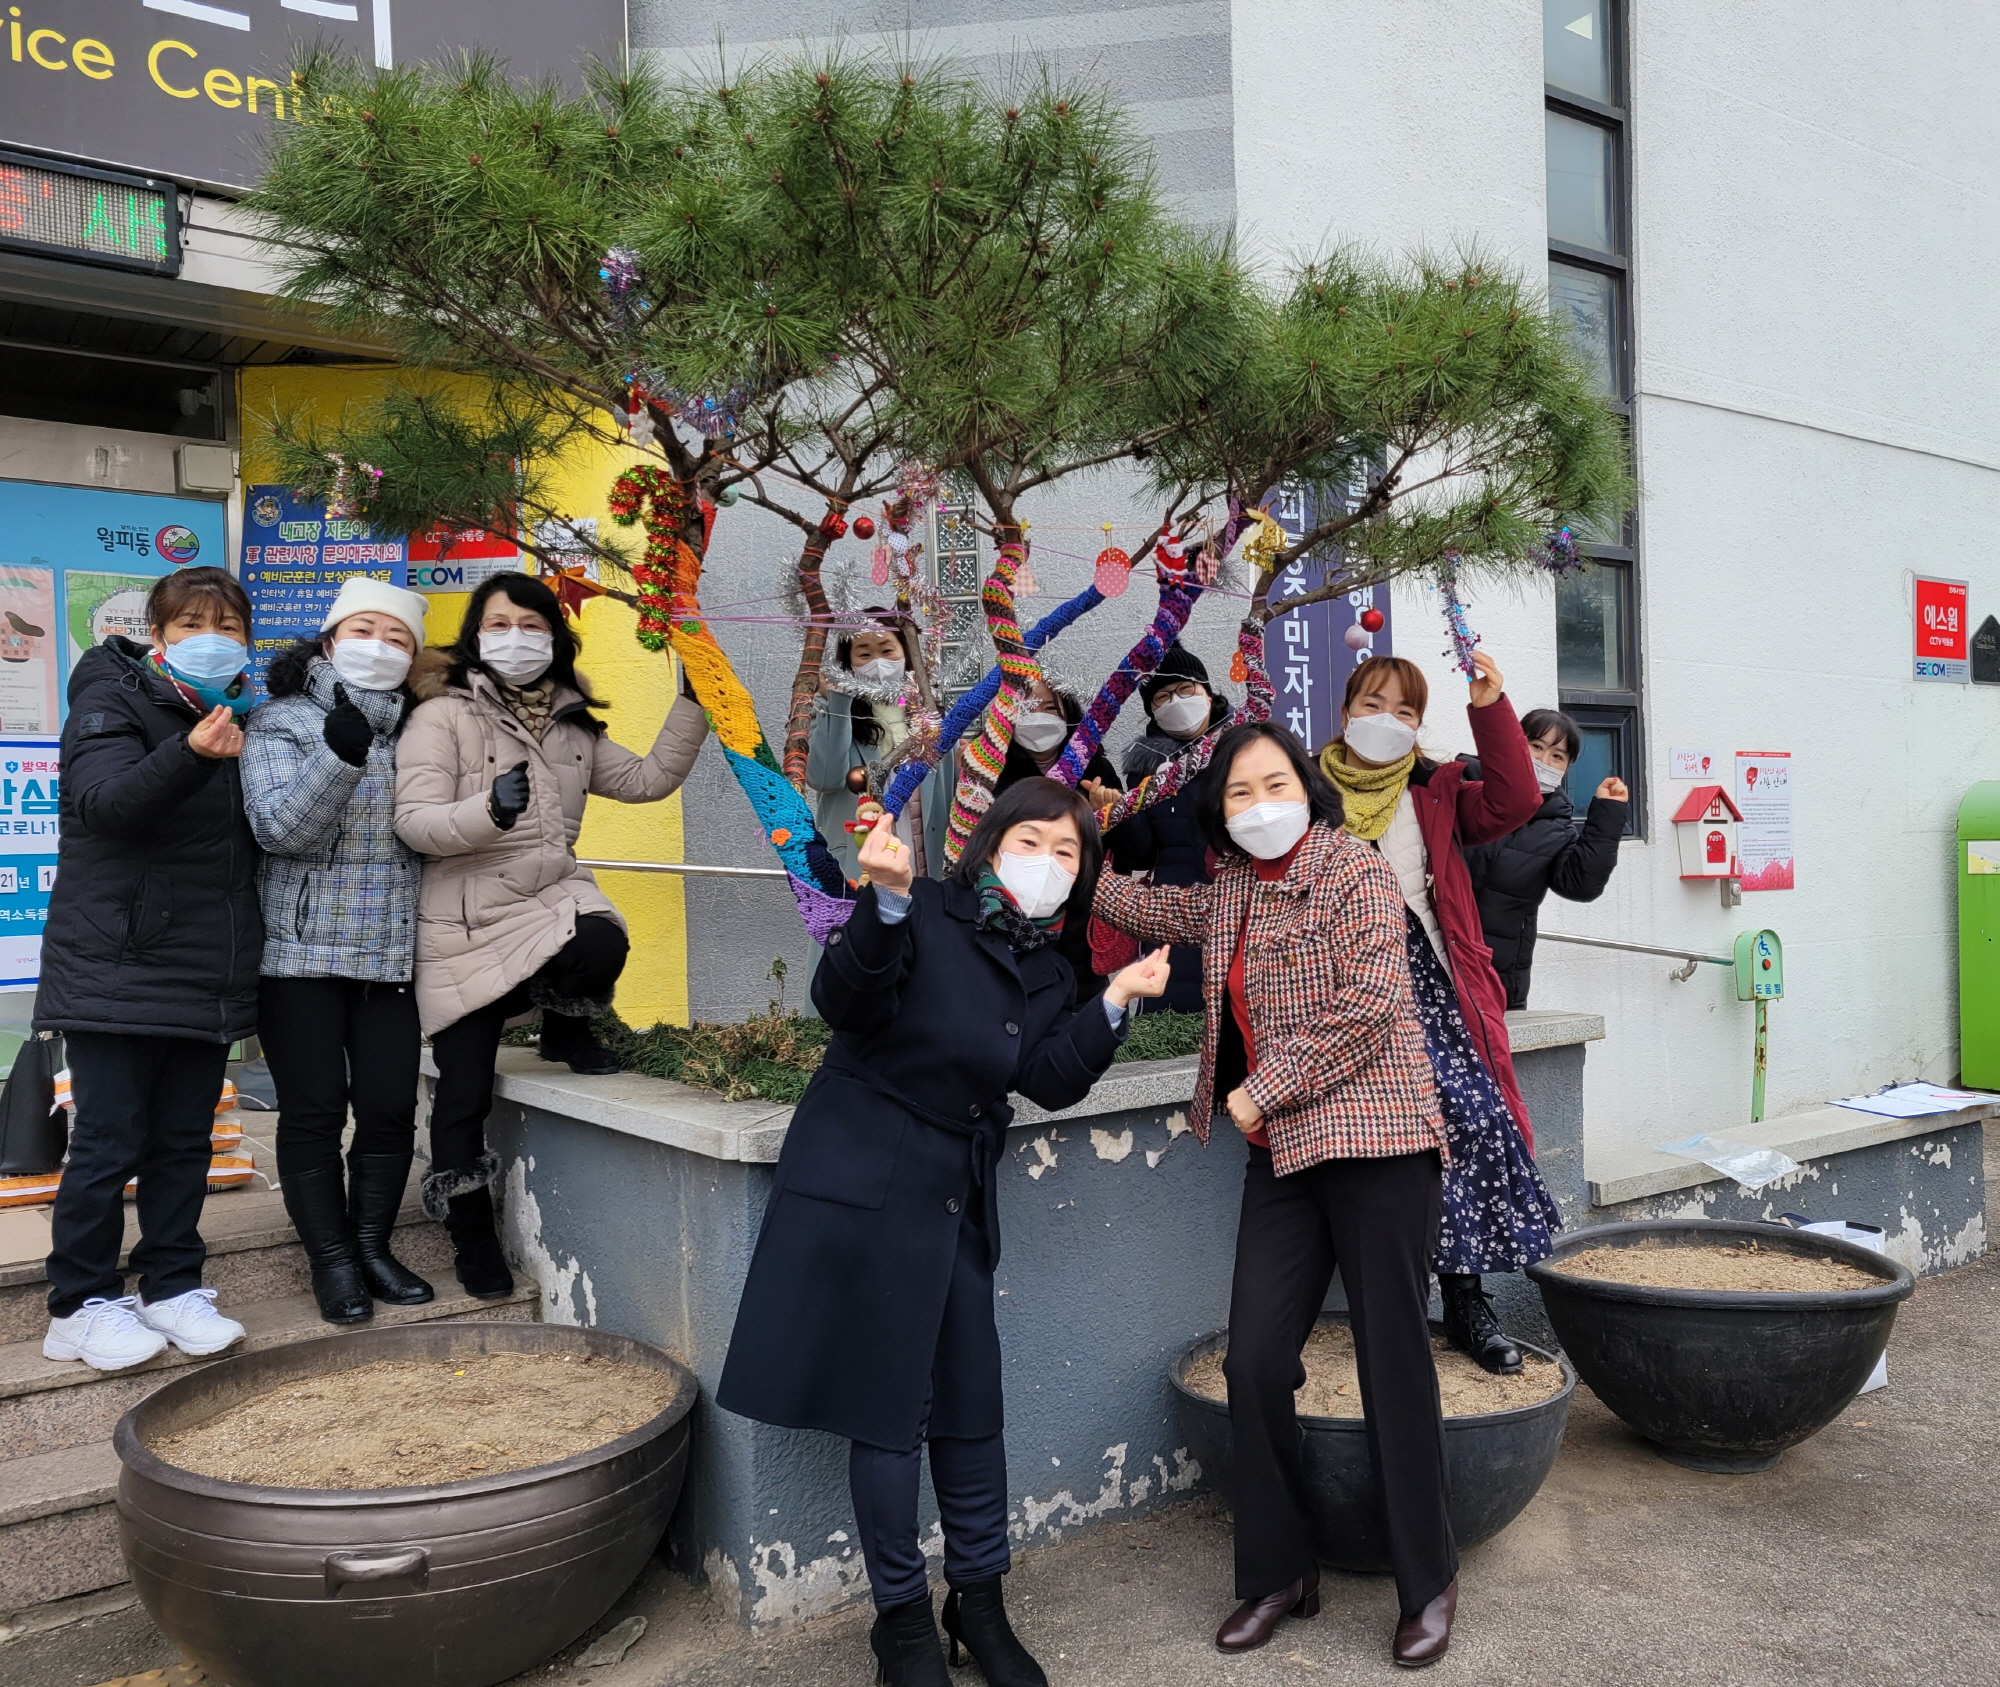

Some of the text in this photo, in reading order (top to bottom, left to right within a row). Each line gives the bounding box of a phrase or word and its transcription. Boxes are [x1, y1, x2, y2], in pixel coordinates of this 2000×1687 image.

[0, 6, 116, 80] ice
[279, 520, 321, 542] 내고장
[96, 526, 151, 557] 월피동
[264, 545, 318, 565] 관련사항
[323, 543, 403, 564] 문의해주세요!
[259, 570, 317, 585] 예비군훈련
[406, 567, 464, 587] ECOM
[260, 588, 287, 599] 인터넷
[259, 602, 302, 613] 예비군훈련
[304, 602, 322, 612] 연기
[1924, 604, 1958, 633] 에스원
[99, 625, 137, 637] 사다리가
[1916, 662, 1946, 676] SECOM
[1677, 752, 1696, 763] 사랑의
[1755, 983, 1782, 995] 도움벨
